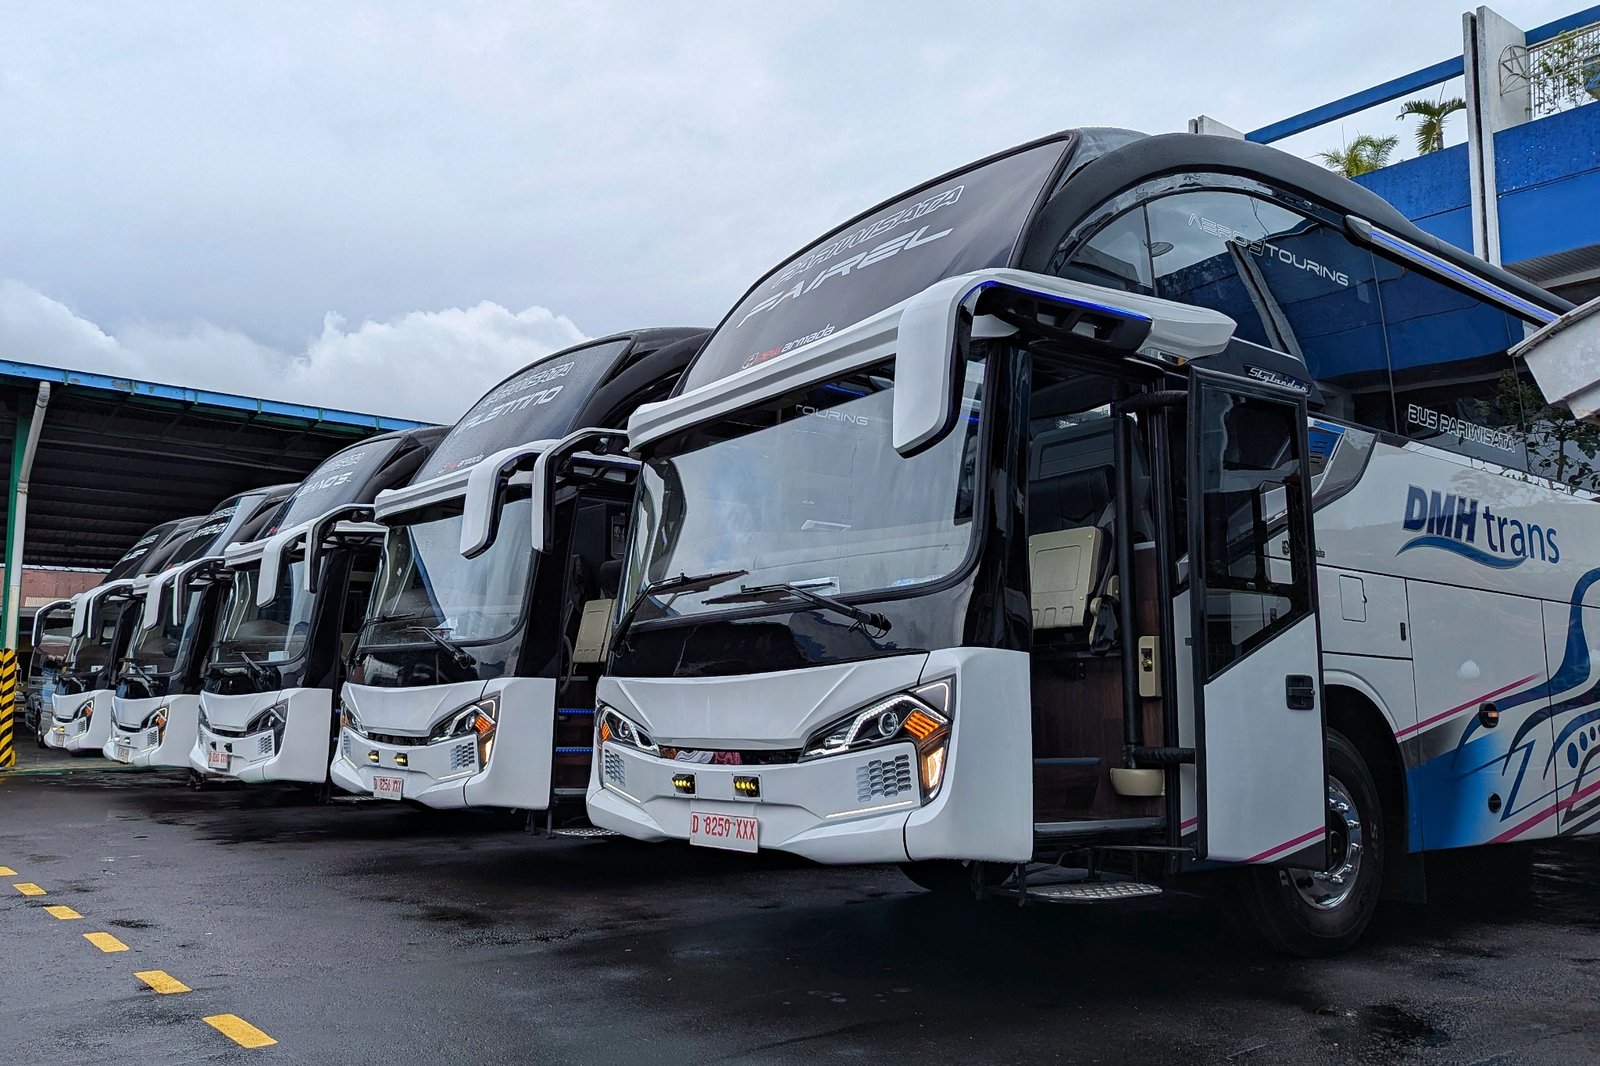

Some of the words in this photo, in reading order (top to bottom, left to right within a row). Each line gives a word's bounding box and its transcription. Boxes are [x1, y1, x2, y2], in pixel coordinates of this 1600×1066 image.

[771, 184, 965, 290] PARIWISATA
[1265, 242, 1349, 287] TOURING
[781, 323, 836, 353] armada
[795, 404, 869, 426] TOURING
[1408, 403, 1437, 430] BUS
[1440, 413, 1516, 453] PARIWISATA
[1402, 483, 1479, 544] DMH
[1482, 505, 1561, 565] trans
[692, 814, 699, 833] D
[704, 816, 731, 838] 8259
[735, 818, 756, 841] XXX
